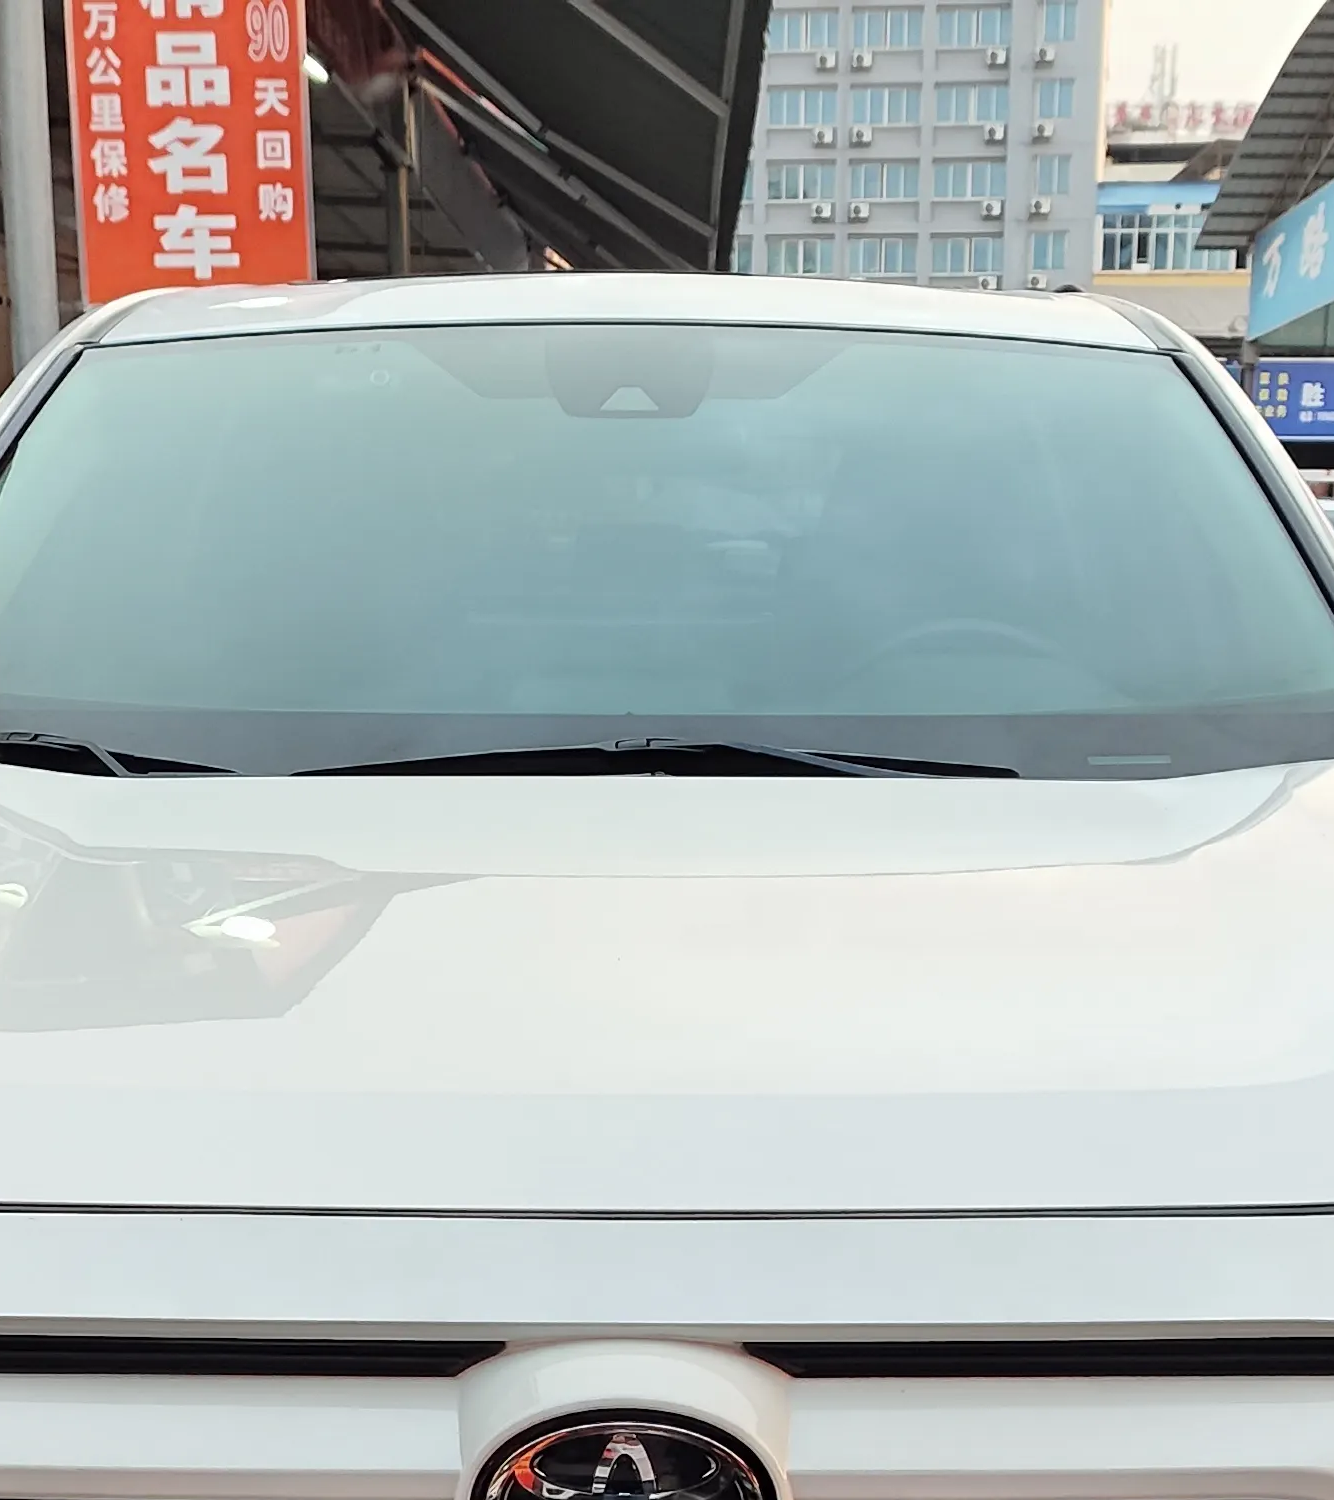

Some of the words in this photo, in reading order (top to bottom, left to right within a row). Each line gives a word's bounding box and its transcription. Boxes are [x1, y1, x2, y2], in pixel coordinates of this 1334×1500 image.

[139, 0, 241, 280] 品名车
[246, 0, 294, 222] 90天回购
